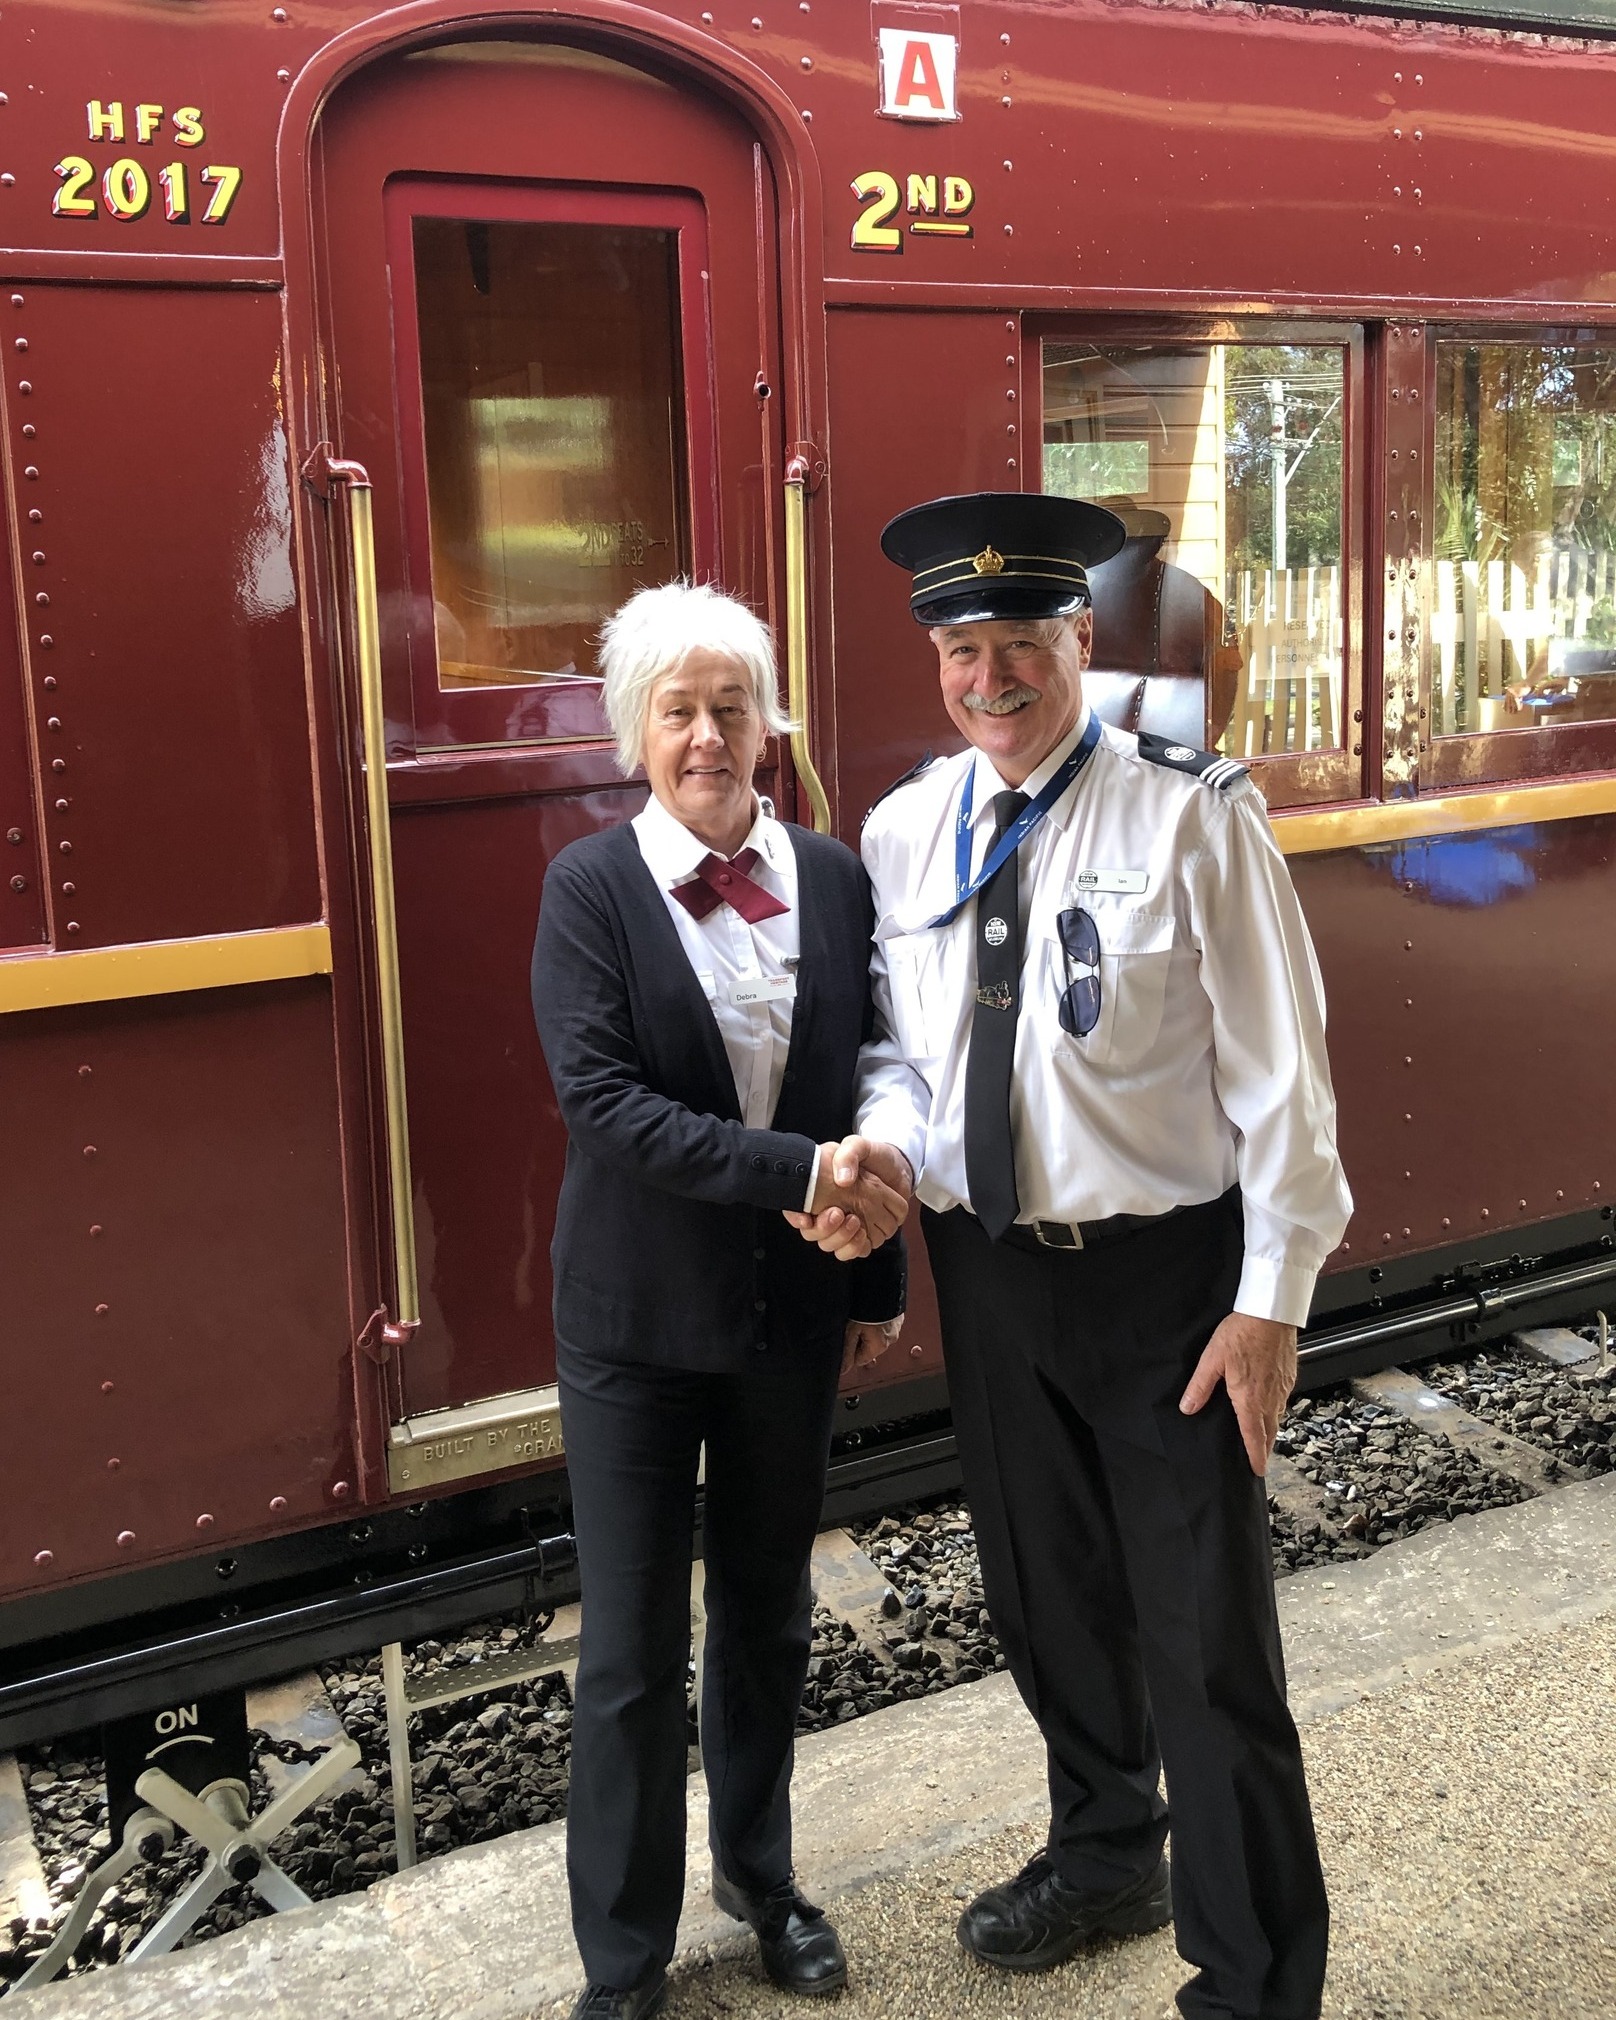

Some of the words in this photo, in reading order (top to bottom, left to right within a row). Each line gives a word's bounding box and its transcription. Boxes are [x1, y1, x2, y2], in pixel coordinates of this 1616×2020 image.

[894, 40, 945, 109] A
[87, 100, 206, 147] HFS
[52, 155, 243, 225] 2017
[850, 170, 975, 255] 2ND
[631, 545, 644, 567] 32
[987, 927, 1005, 936] RAIL
[736, 993, 757, 1001] Debra
[423, 1437, 474, 1461] BUILT
[487, 1428, 508, 1447] BY
[517, 1418, 551, 1439] THE
[154, 1703, 198, 1734] ON
